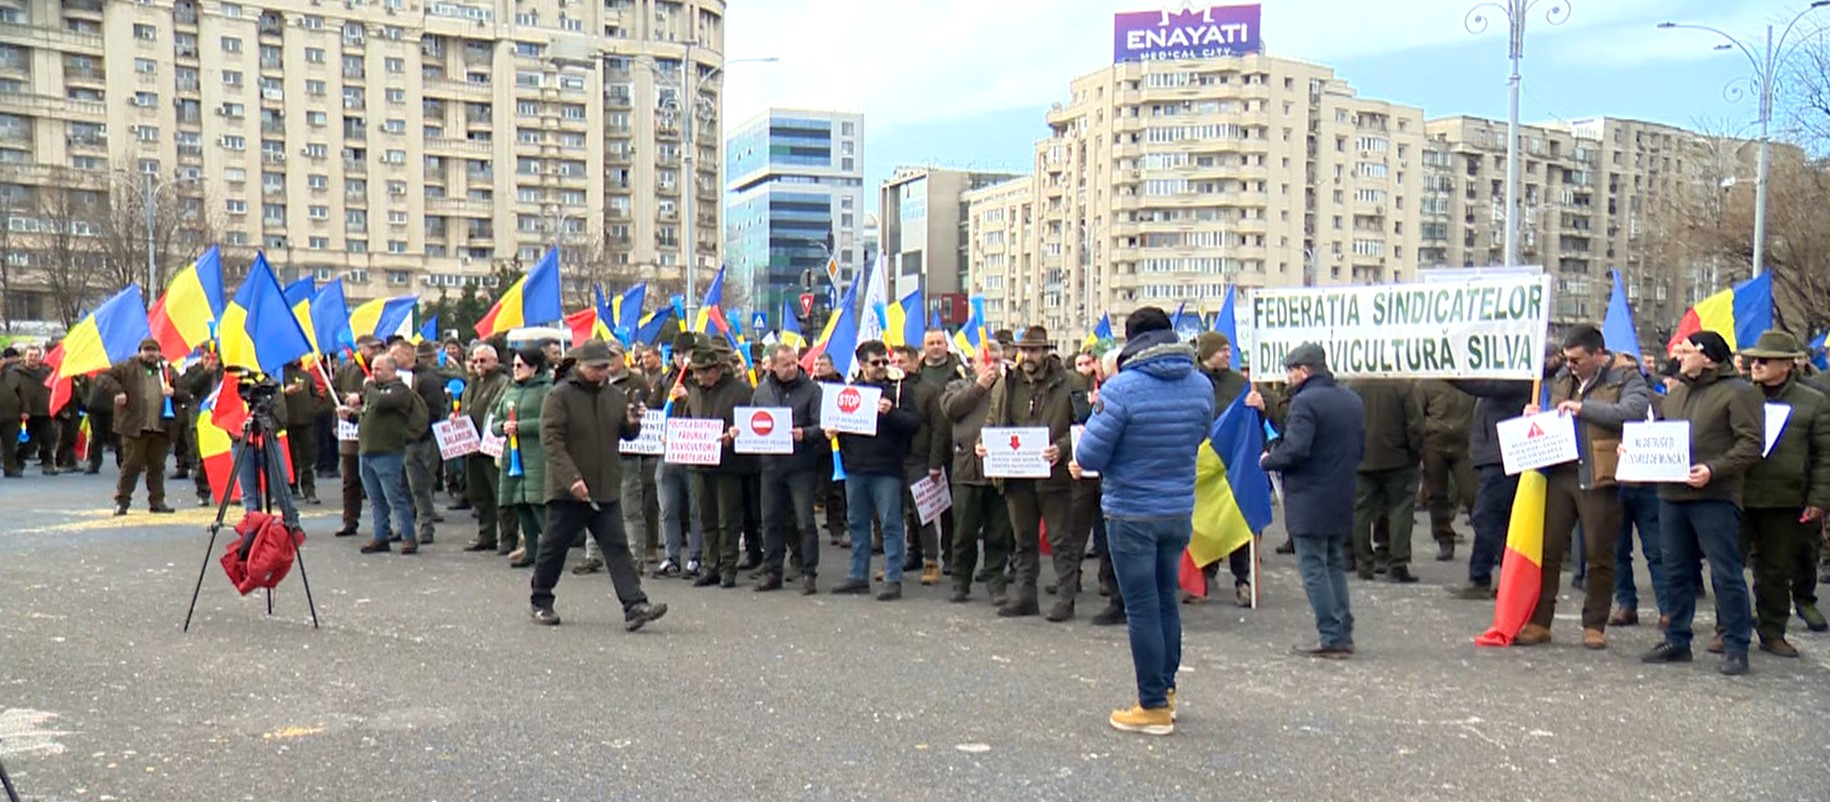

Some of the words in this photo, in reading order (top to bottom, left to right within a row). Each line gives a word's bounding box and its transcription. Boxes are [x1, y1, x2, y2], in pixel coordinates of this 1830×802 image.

[1127, 23, 1248, 49] ENAYATI
[1140, 49, 1196, 60] MEDICAL
[1202, 47, 1231, 57] CITY
[1372, 284, 1543, 326] SINDICATELOR
[1260, 340, 1289, 374] DIN
[1302, 329, 1456, 374] VICULTURĂ
[1467, 334, 1532, 371] SILVA
[838, 393, 861, 408] STOP
